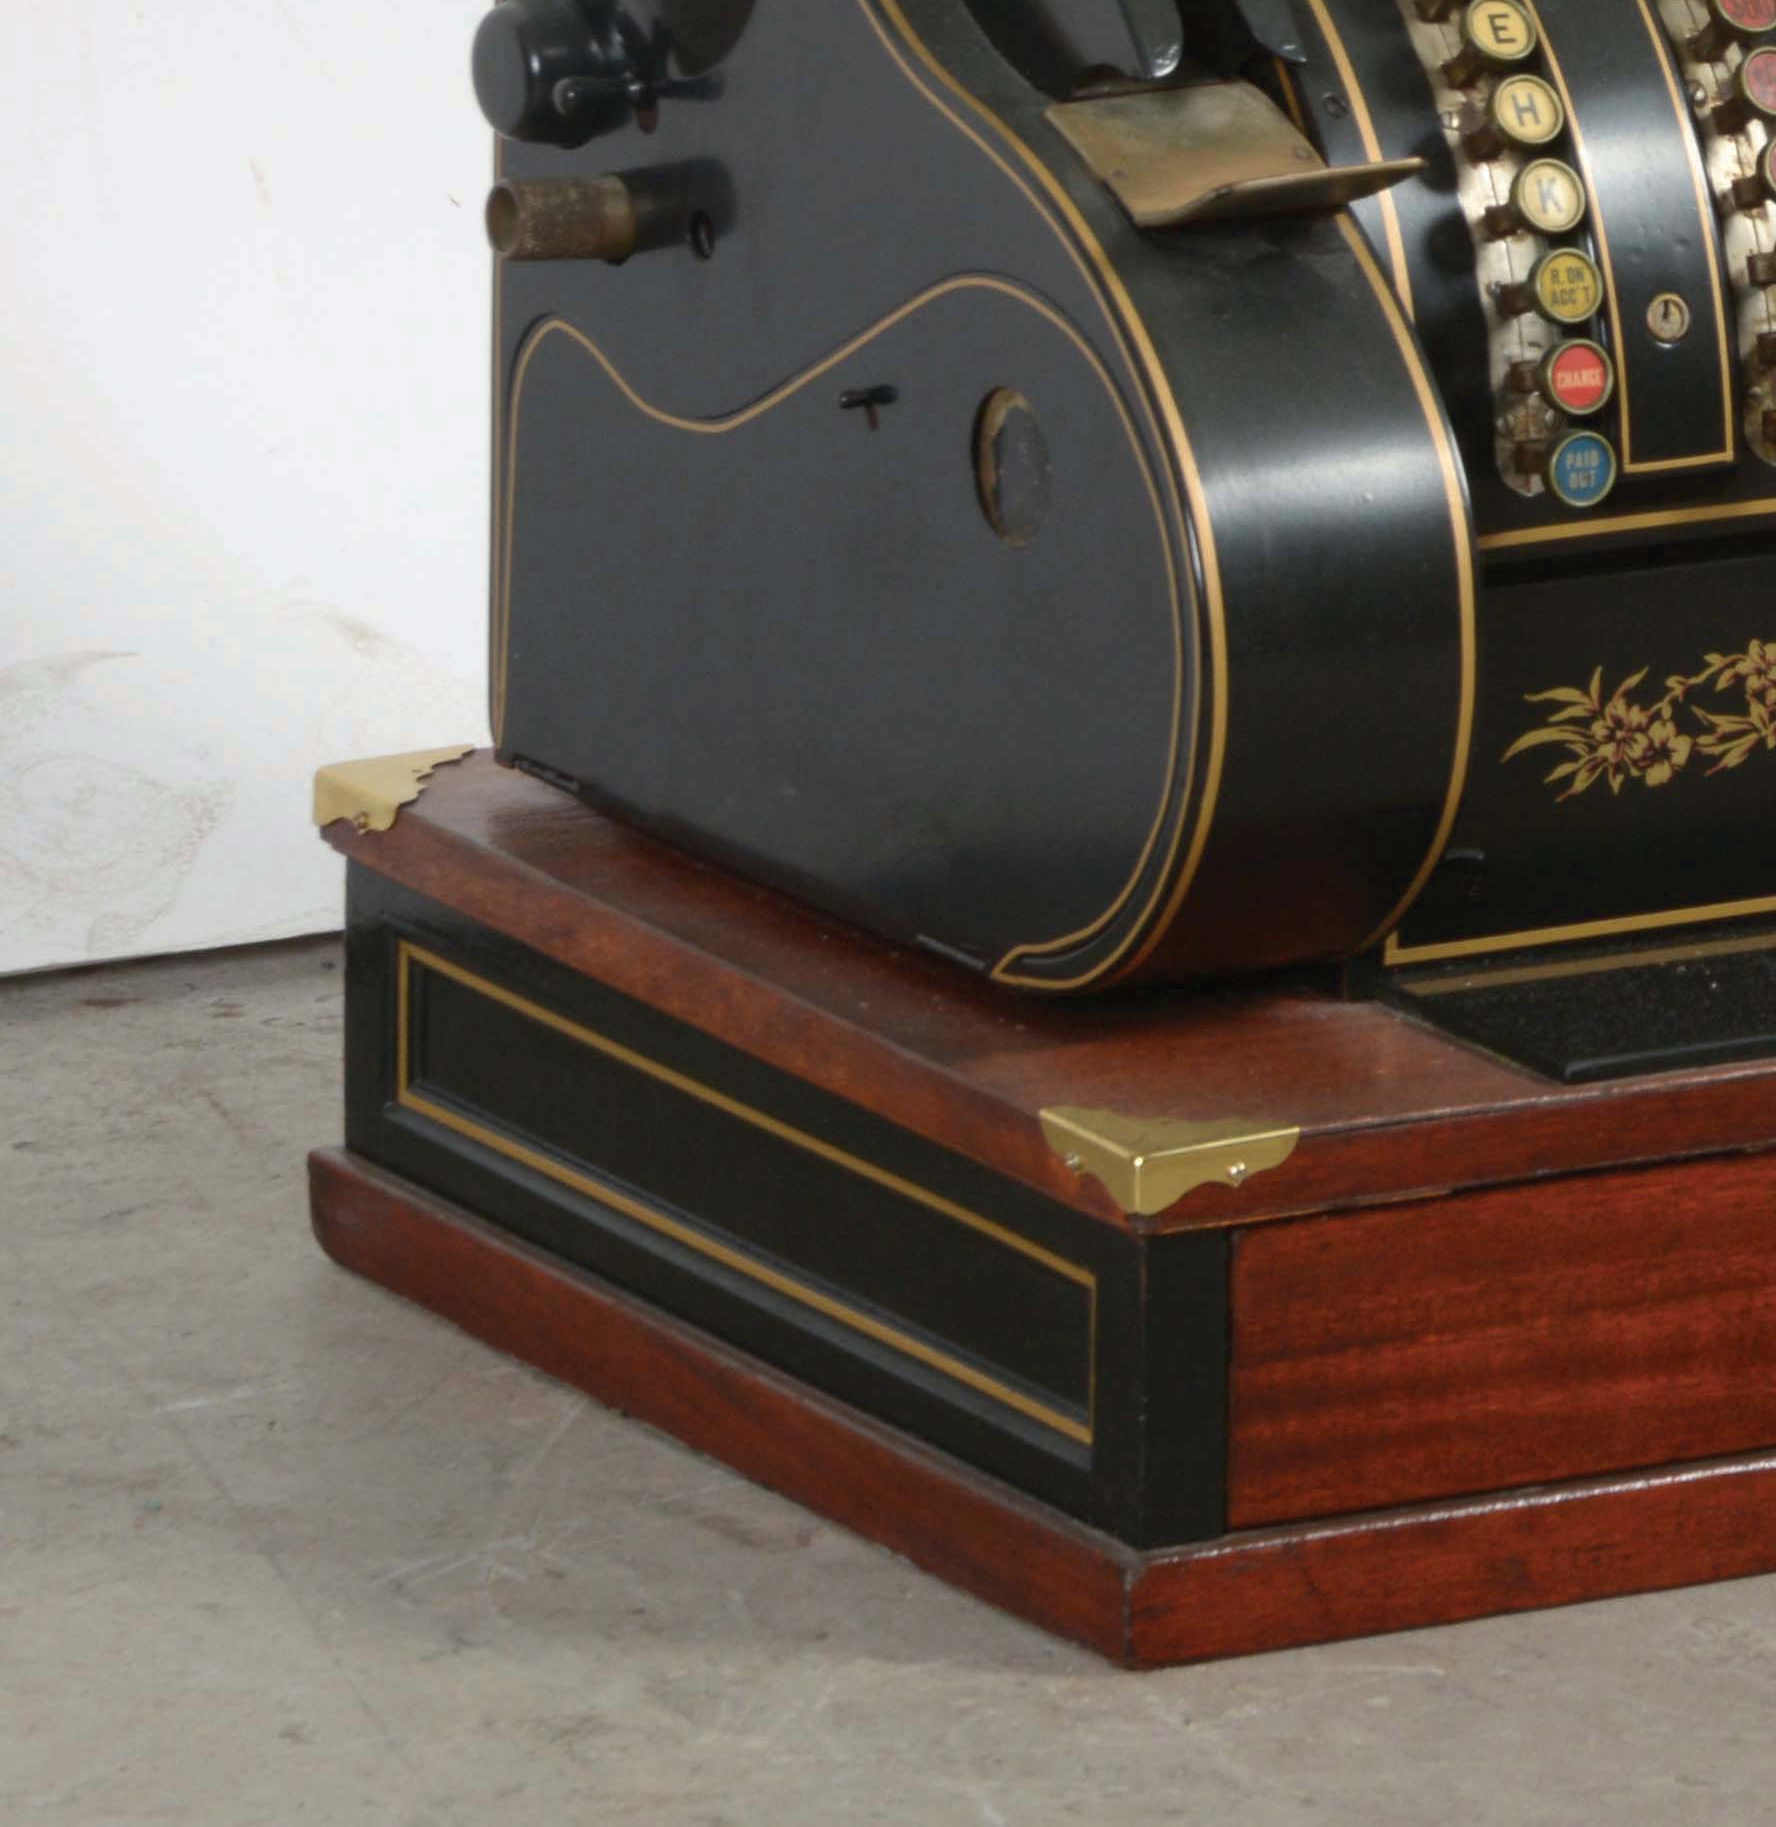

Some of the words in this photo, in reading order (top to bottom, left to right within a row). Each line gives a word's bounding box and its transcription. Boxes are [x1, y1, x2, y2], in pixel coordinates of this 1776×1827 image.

[1487, 13, 1518, 45] E
[1510, 92, 1541, 127] H
[1536, 176, 1565, 214] K
